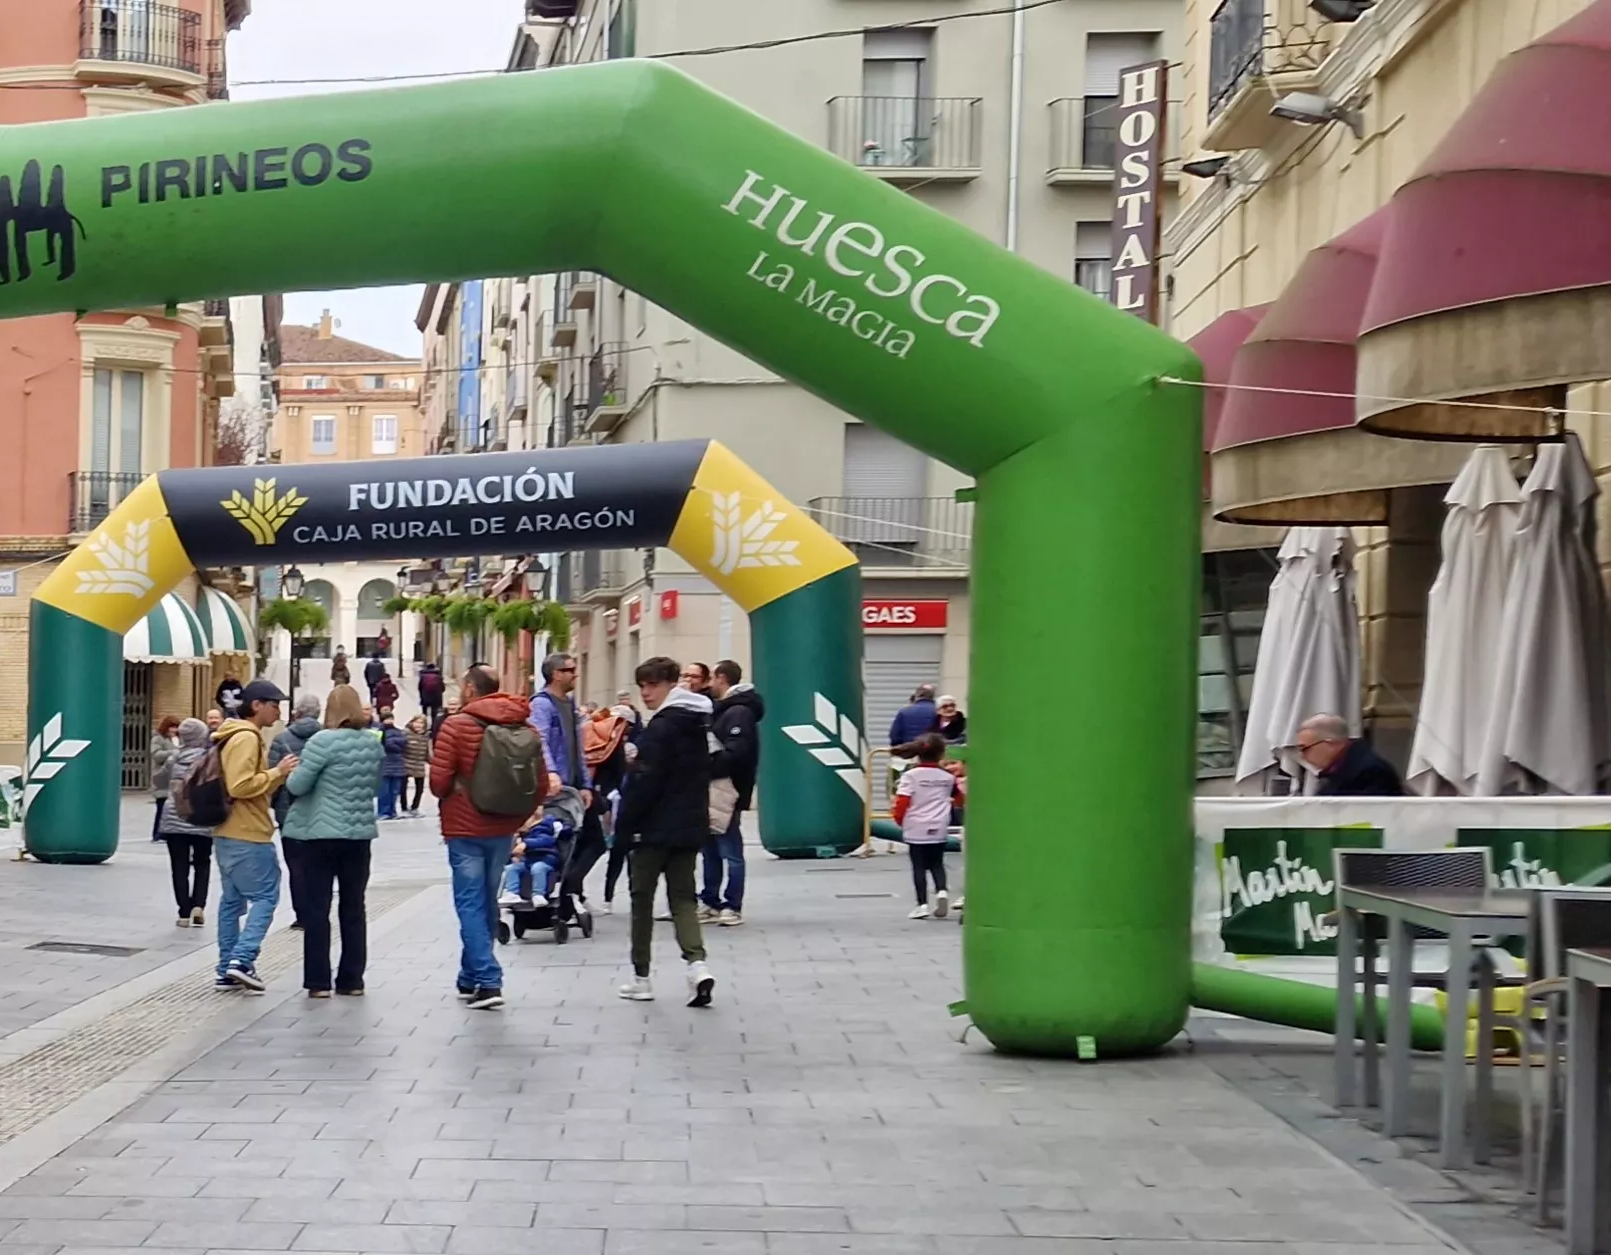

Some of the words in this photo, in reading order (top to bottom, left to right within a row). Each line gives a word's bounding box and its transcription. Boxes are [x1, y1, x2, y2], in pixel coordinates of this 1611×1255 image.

[101, 138, 373, 208] PIRINEOS
[1112, 67, 1159, 310] HOSTAL
[720, 169, 1001, 348] Huesca
[747, 250, 795, 293] La
[348, 466, 576, 511] FUNDACIÓN
[292, 523, 362, 544] CAJA
[370, 517, 460, 540] RURAL
[469, 516, 507, 534] DE
[515, 505, 636, 532] ARAGÓN
[861, 606, 917, 623] GAES
